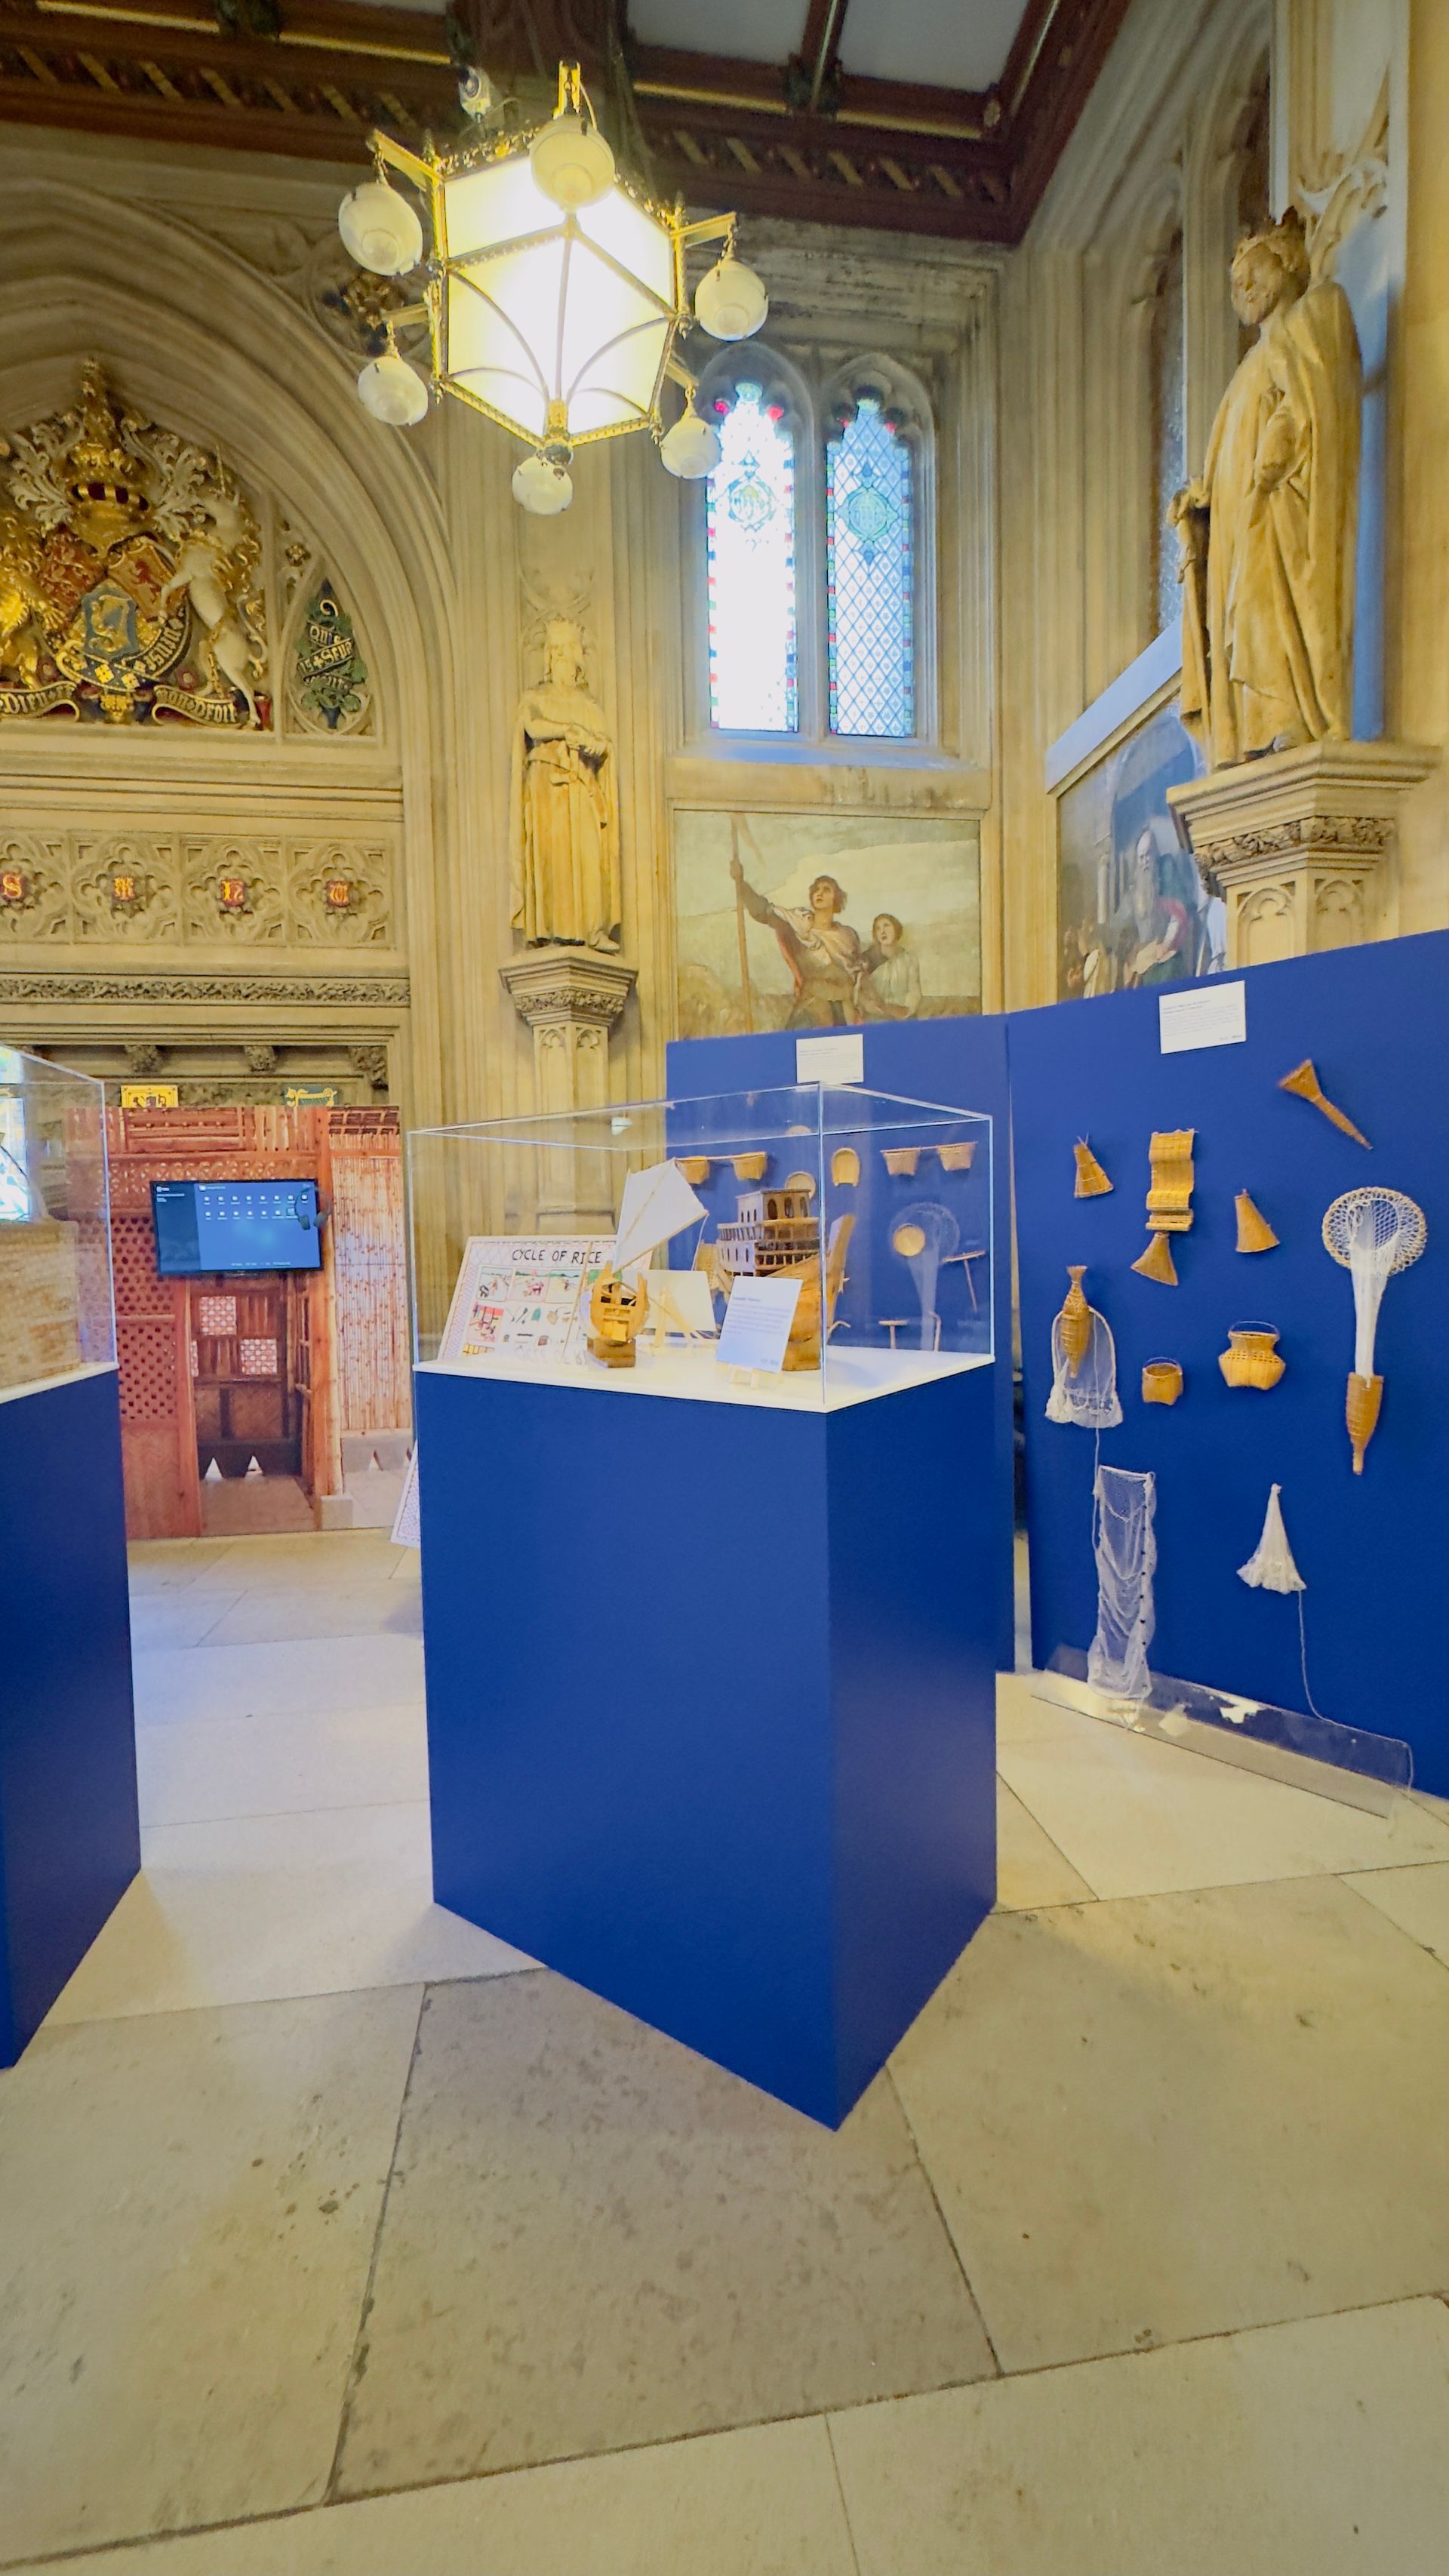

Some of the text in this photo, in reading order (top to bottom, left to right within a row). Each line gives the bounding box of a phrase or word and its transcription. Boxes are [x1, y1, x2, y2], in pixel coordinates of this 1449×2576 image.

[512, 1249, 602, 1264] CYCLE OF RICE
